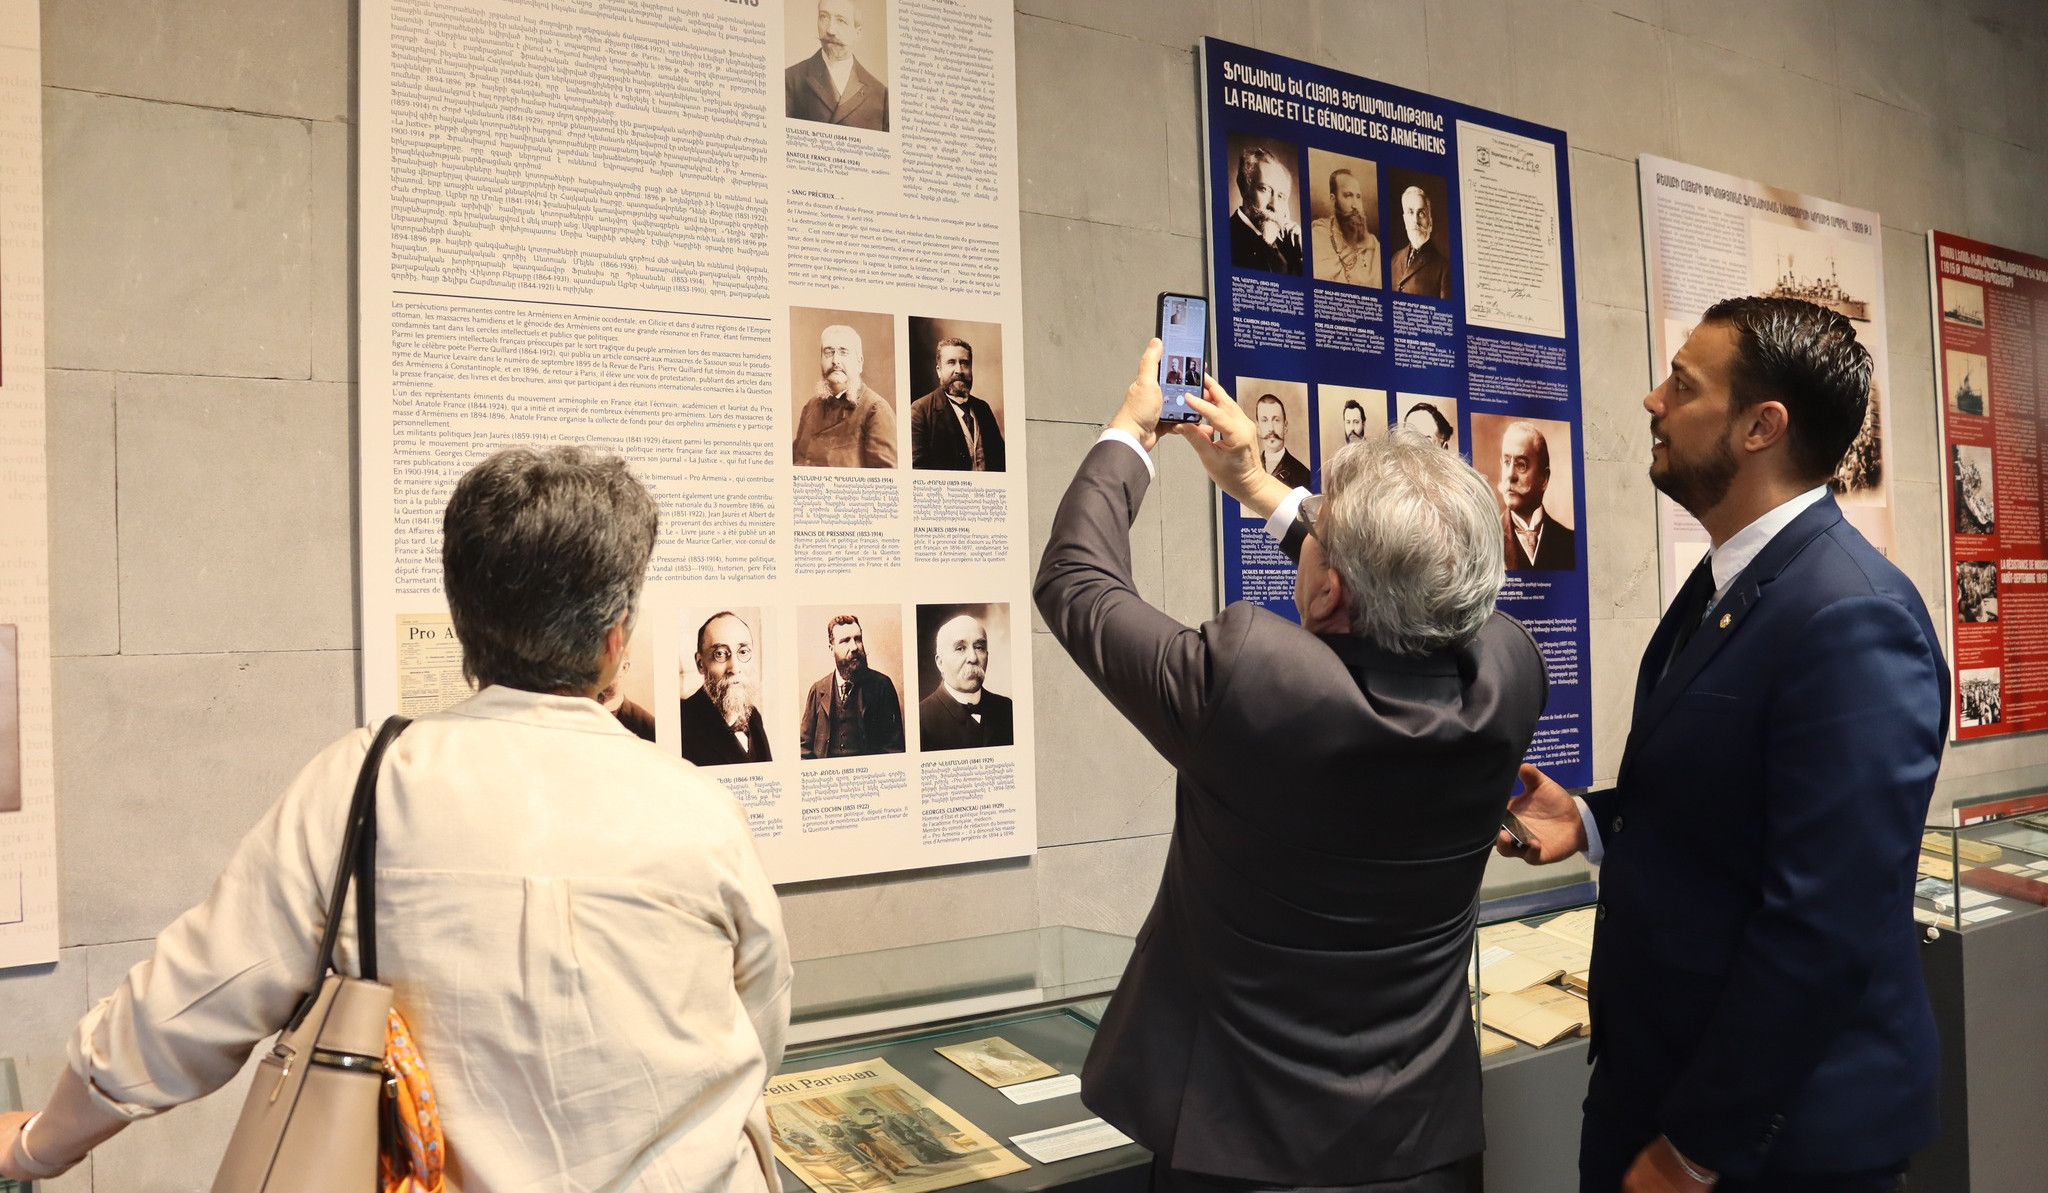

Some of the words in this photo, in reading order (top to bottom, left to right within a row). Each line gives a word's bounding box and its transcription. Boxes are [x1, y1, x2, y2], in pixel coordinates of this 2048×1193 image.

[1224, 61, 1286, 93] ՖՐԱՆՍԻԱՆ
[1288, 77, 1303, 97] ԵՎ
[1306, 82, 1339, 106] ՀԱՅՈՑ
[1224, 86, 1239, 107] LA
[1241, 90, 1284, 118] FRANCE
[1287, 101, 1300, 121] ET
[1302, 105, 1315, 124] LE
[1317, 108, 1368, 137] GÉNOCIDE
[1369, 121, 1388, 142] DES
[1391, 126, 1446, 155] ARMÉNIENS
[405, 303, 448, 312] persécutions
[450, 306, 493, 314] permanentes
[527, 310, 562, 319] Arméniens
[573, 314, 600, 322] Arménie
[601, 316, 638, 325] occidentale,
[648, 319, 667, 327] Cilicie
[691, 322, 715, 330] d'autres
[716, 324, 738, 332] régions
[746, 326, 771, 335] l'Empire
[438, 430, 472, 439] politiques
[473, 431, 488, 439] Jean
[489, 432, 510, 440] Jaurès
[558, 434, 585, 443] Georges
[626, 436, 661, 445] (1841-1929)
[410, 627, 435, 640] Pro
[798, 1070, 878, 1088] Parisien
